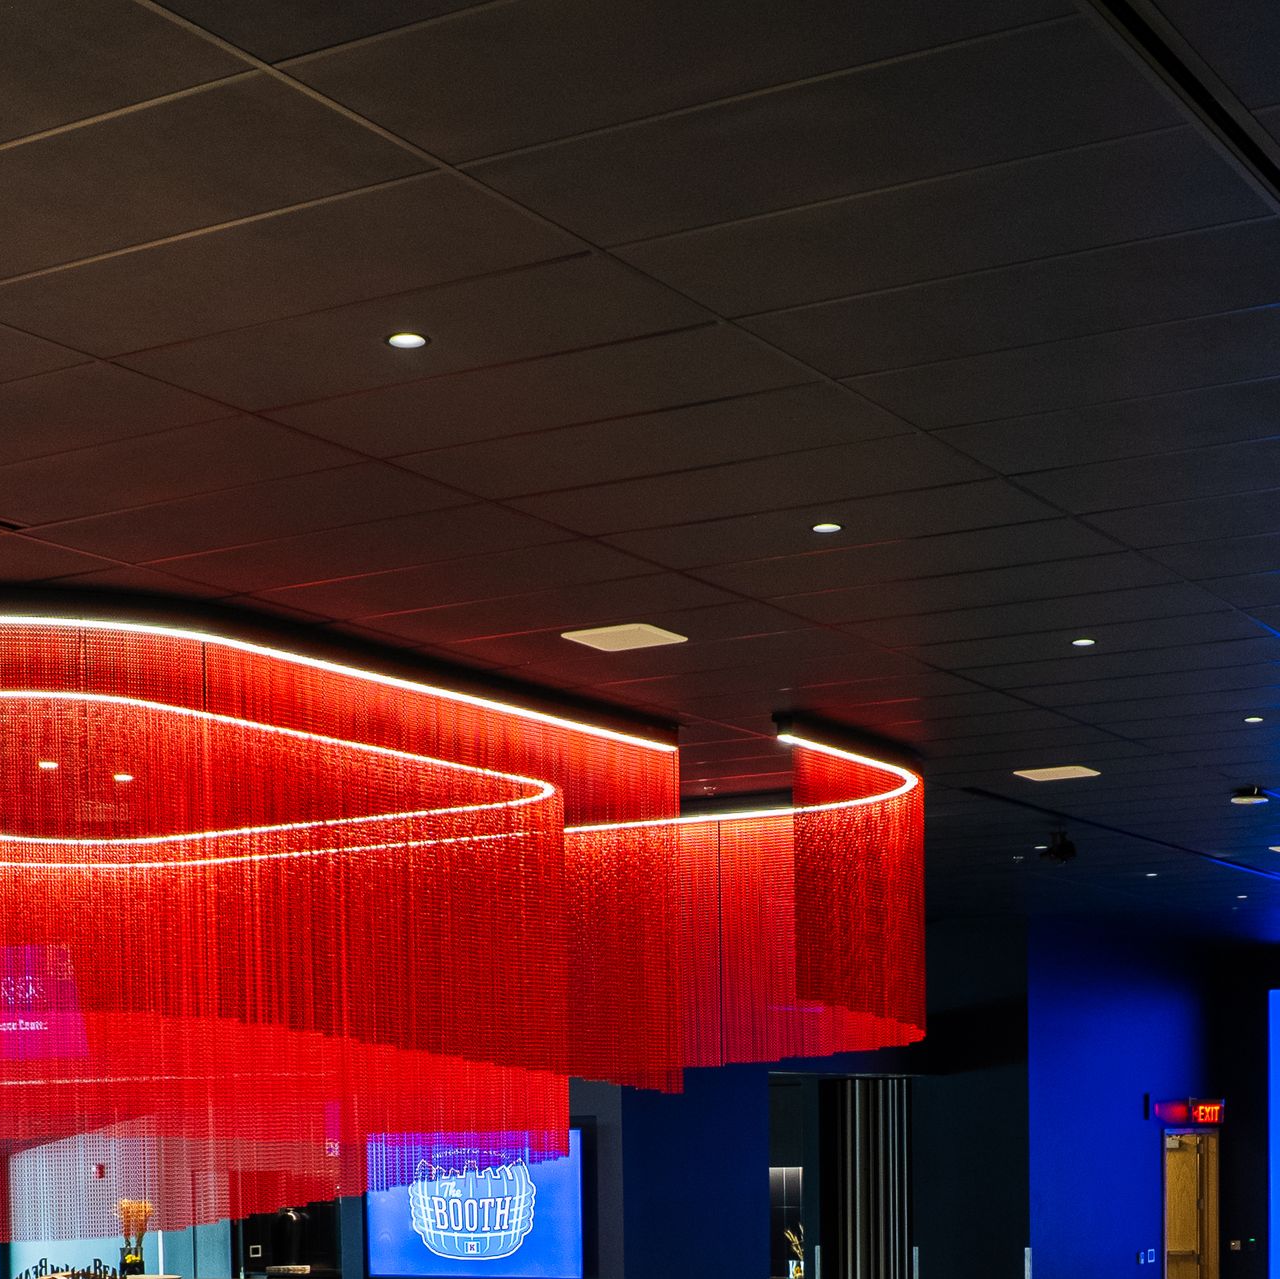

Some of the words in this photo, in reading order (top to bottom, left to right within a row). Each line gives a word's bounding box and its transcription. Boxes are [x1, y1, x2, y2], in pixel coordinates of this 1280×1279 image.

[1199, 1105, 1220, 1121] EXIT
[440, 1181, 463, 1198] The
[431, 1196, 513, 1231] BOOTH
